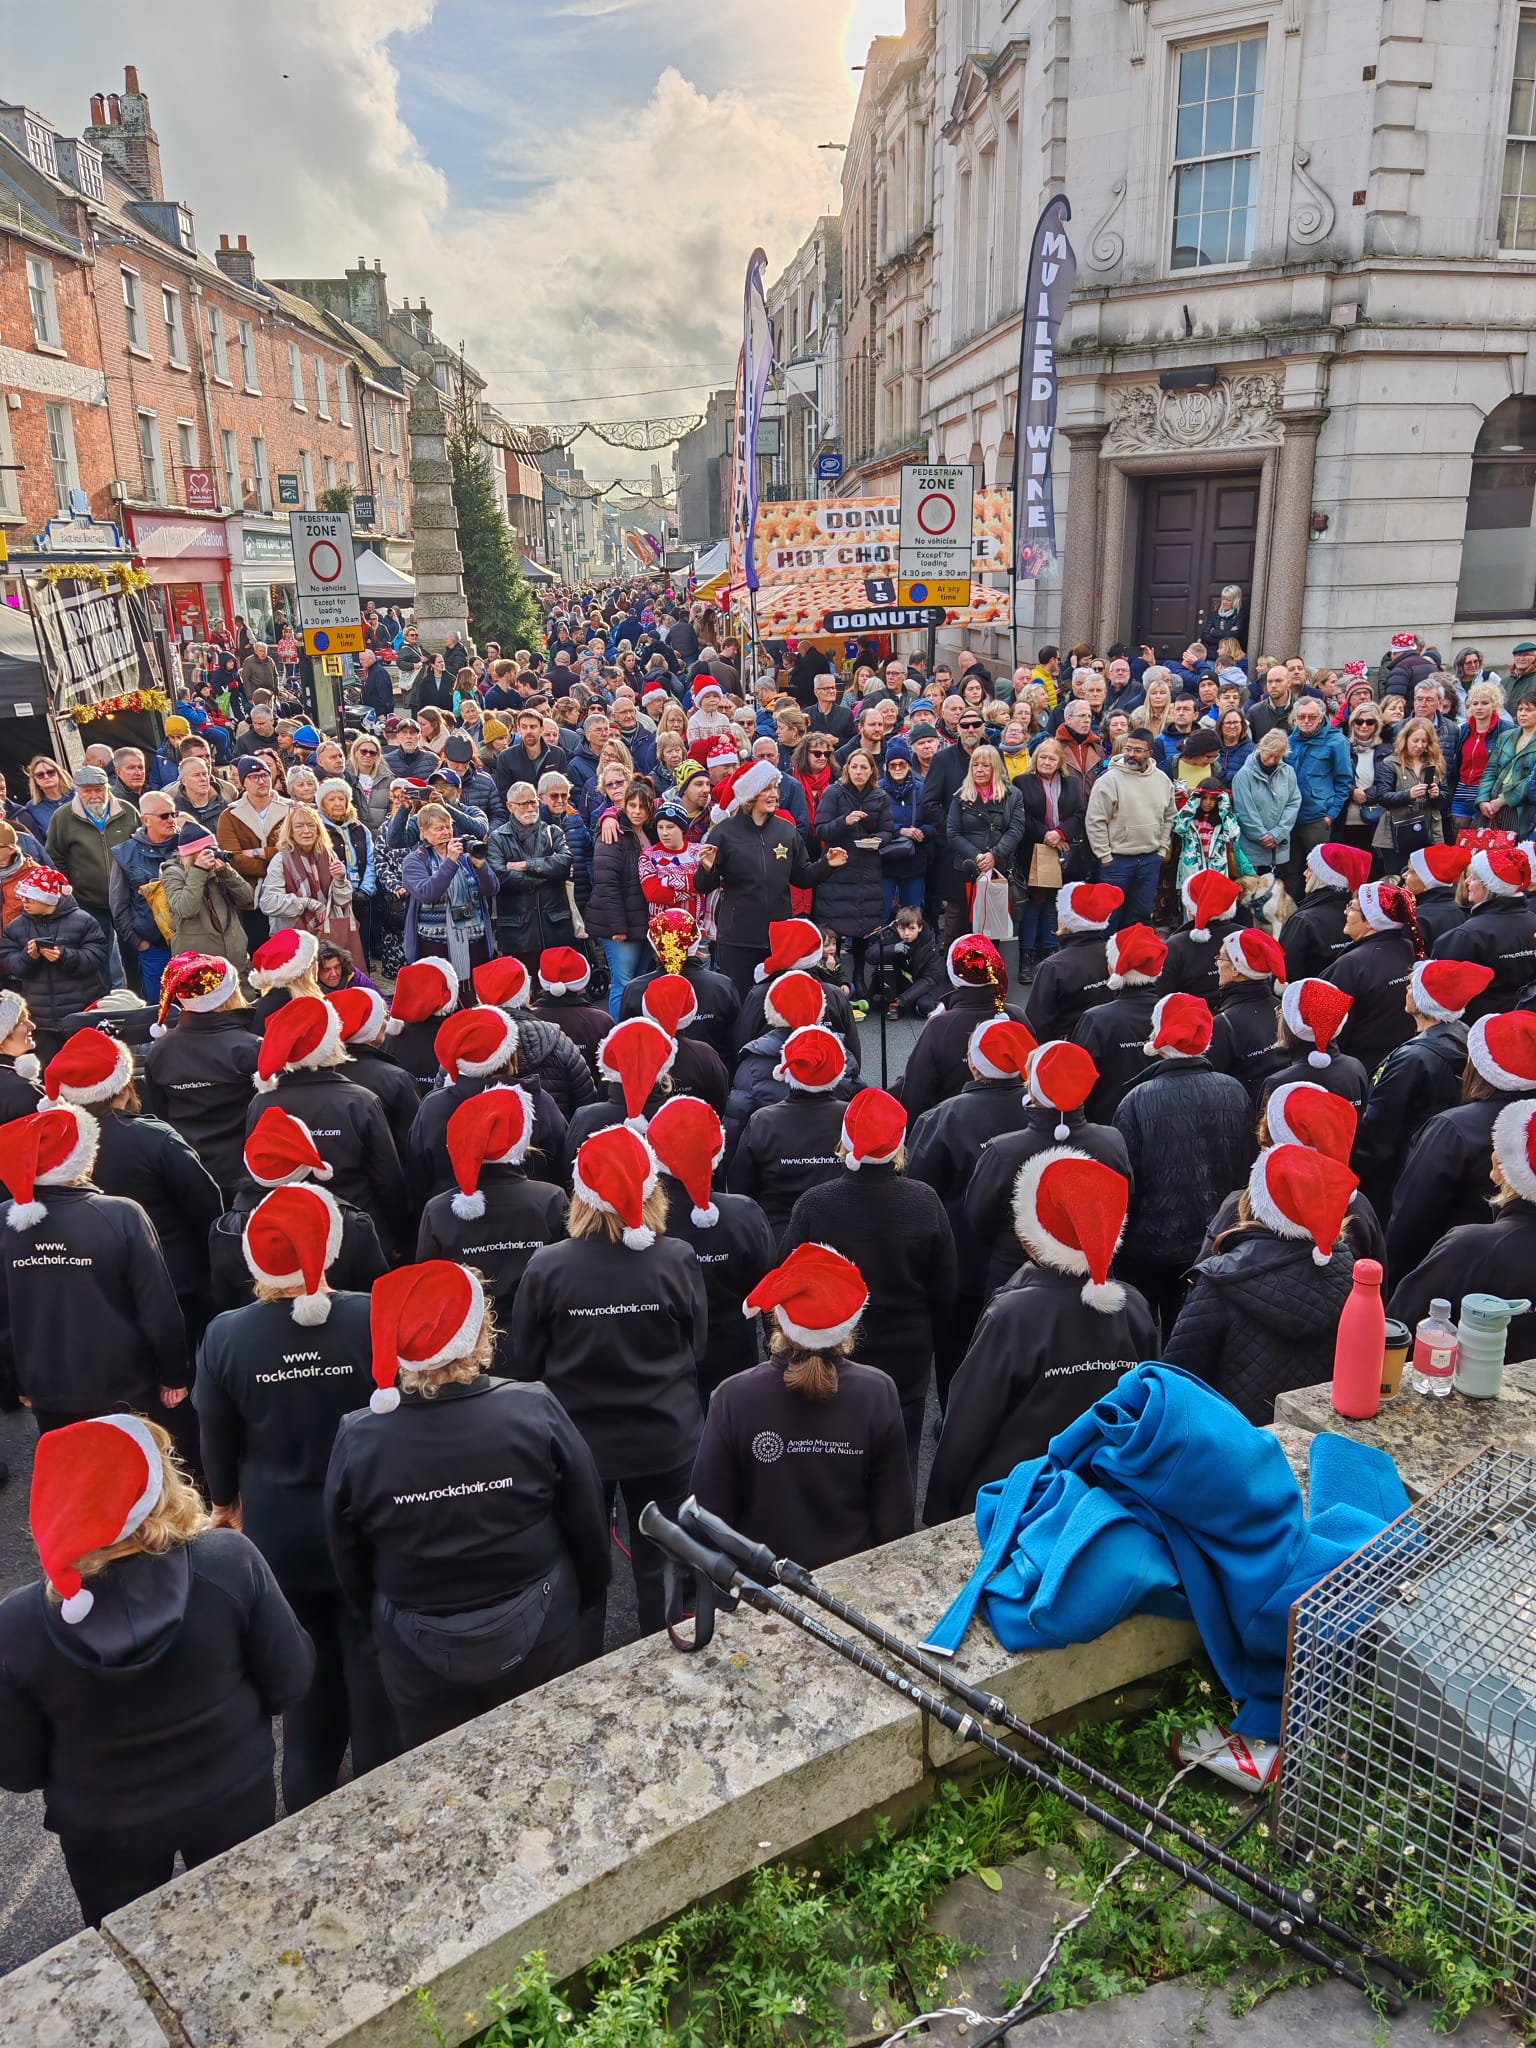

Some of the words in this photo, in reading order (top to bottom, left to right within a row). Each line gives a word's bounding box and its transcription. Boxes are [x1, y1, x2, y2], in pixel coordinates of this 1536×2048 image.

[912, 468, 963, 476] PEDESTRIAN
[1027, 425, 1053, 529] WINE
[919, 478, 955, 490] ZONE
[299, 515, 341, 523] PEDESTRIAN
[827, 503, 900, 529] DONU
[306, 525, 337, 537] ZONE
[927, 537, 957, 545] vehicles
[777, 549, 828, 569] HOT
[916, 551, 942, 560] Except
[943, 551, 954, 559] for
[920, 559, 948, 568] loading
[921, 570, 932, 578] pm
[322, 584, 347, 592] vehicles
[940, 593, 957, 601] time
[313, 599, 336, 607] Except
[319, 607, 342, 615] loading
[345, 632, 356, 640] any
[340, 640, 354, 648] time
[780, 1155, 842, 1166] www.rockchoir.c
[34, 1243, 67, 1252] www.
[462, 1240, 544, 1255] www.rockchoir.com
[12, 1254, 93, 1269] rockchoir.com
[567, 1302, 660, 1317] www.rockchoir.com
[282, 1350, 322, 1364] www.
[1044, 1358, 1137, 1379] www.rockchoir.com
[255, 1364, 354, 1383] rockchoir.com
[815, 1440, 850, 1448] Marmont
[825, 1446, 836, 1454] UK
[392, 1477, 514, 1505] www.rockchoir.com
